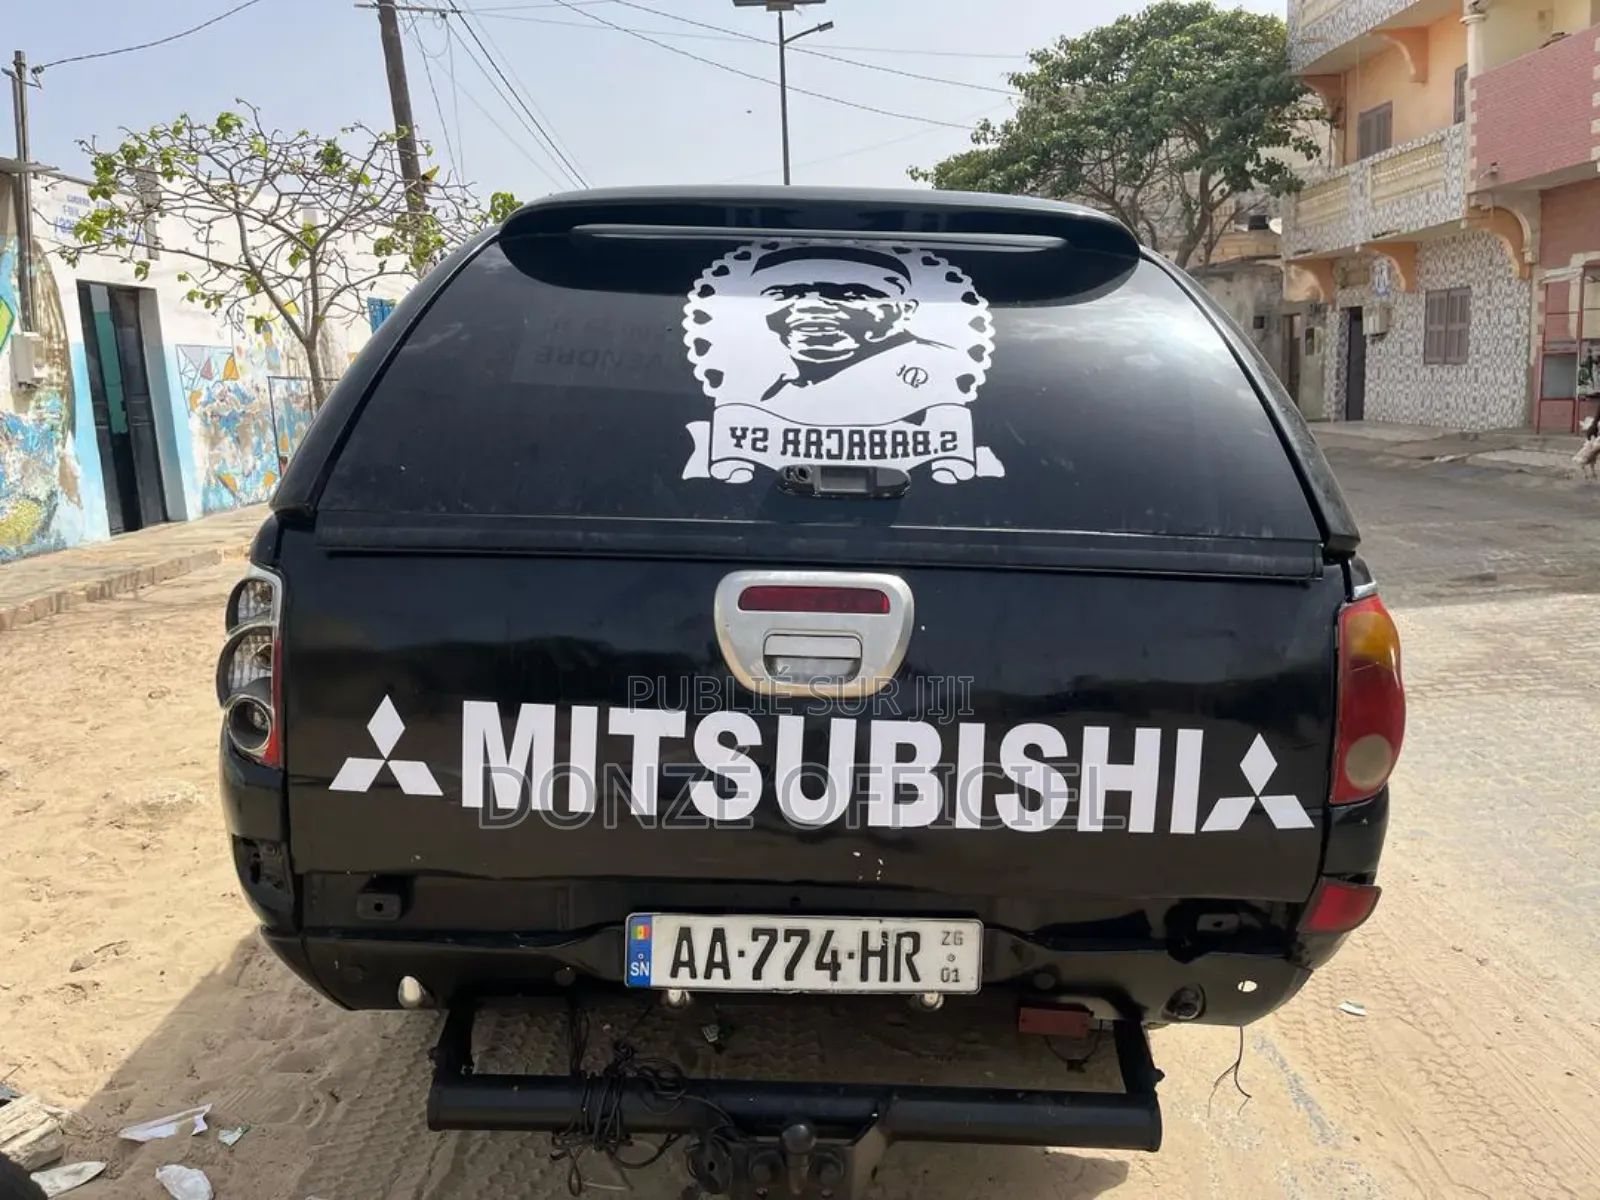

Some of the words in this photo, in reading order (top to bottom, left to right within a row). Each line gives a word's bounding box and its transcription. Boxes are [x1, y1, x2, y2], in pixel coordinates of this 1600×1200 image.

[462, 700, 1204, 834] MITSUBISHI
[941, 930, 964, 946] ZG
[630, 961, 650, 977] SN
[940, 967, 960, 983] 01
